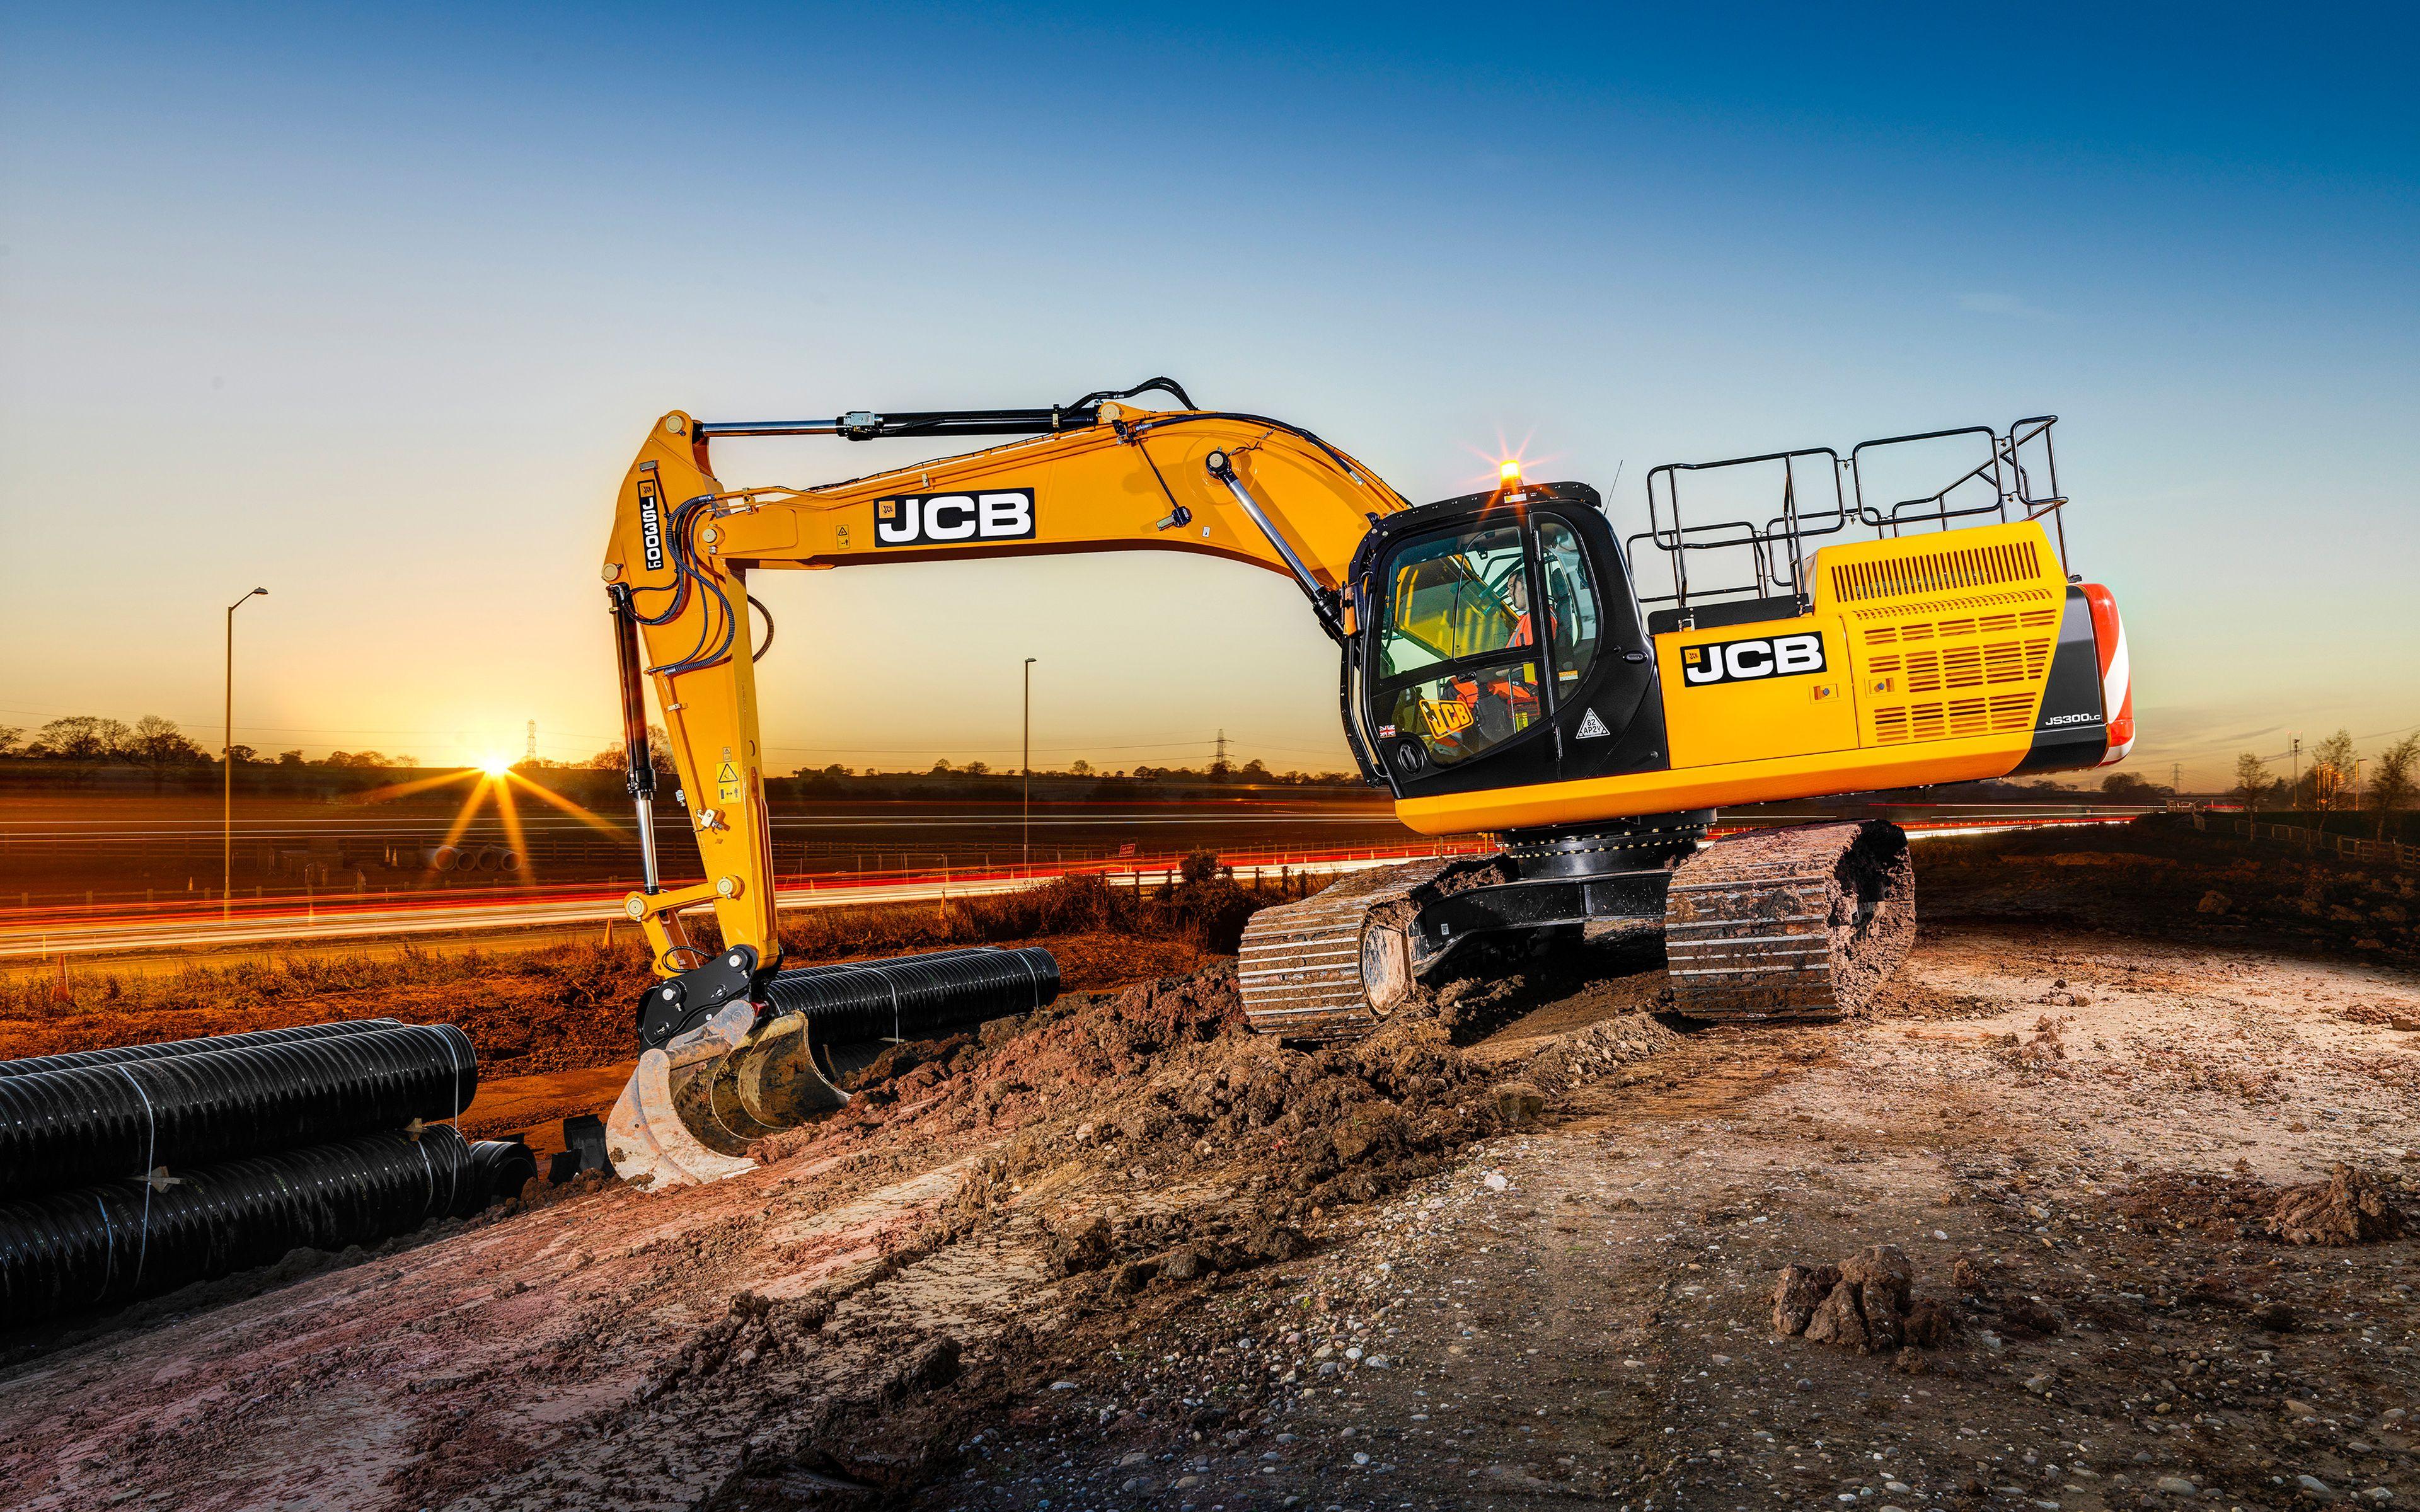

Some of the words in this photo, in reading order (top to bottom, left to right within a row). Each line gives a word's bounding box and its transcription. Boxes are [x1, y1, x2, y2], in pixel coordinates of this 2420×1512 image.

[879, 493, 1031, 542] JCB
[1686, 635, 1823, 683] JCB
[1429, 703, 1470, 734] JCB
